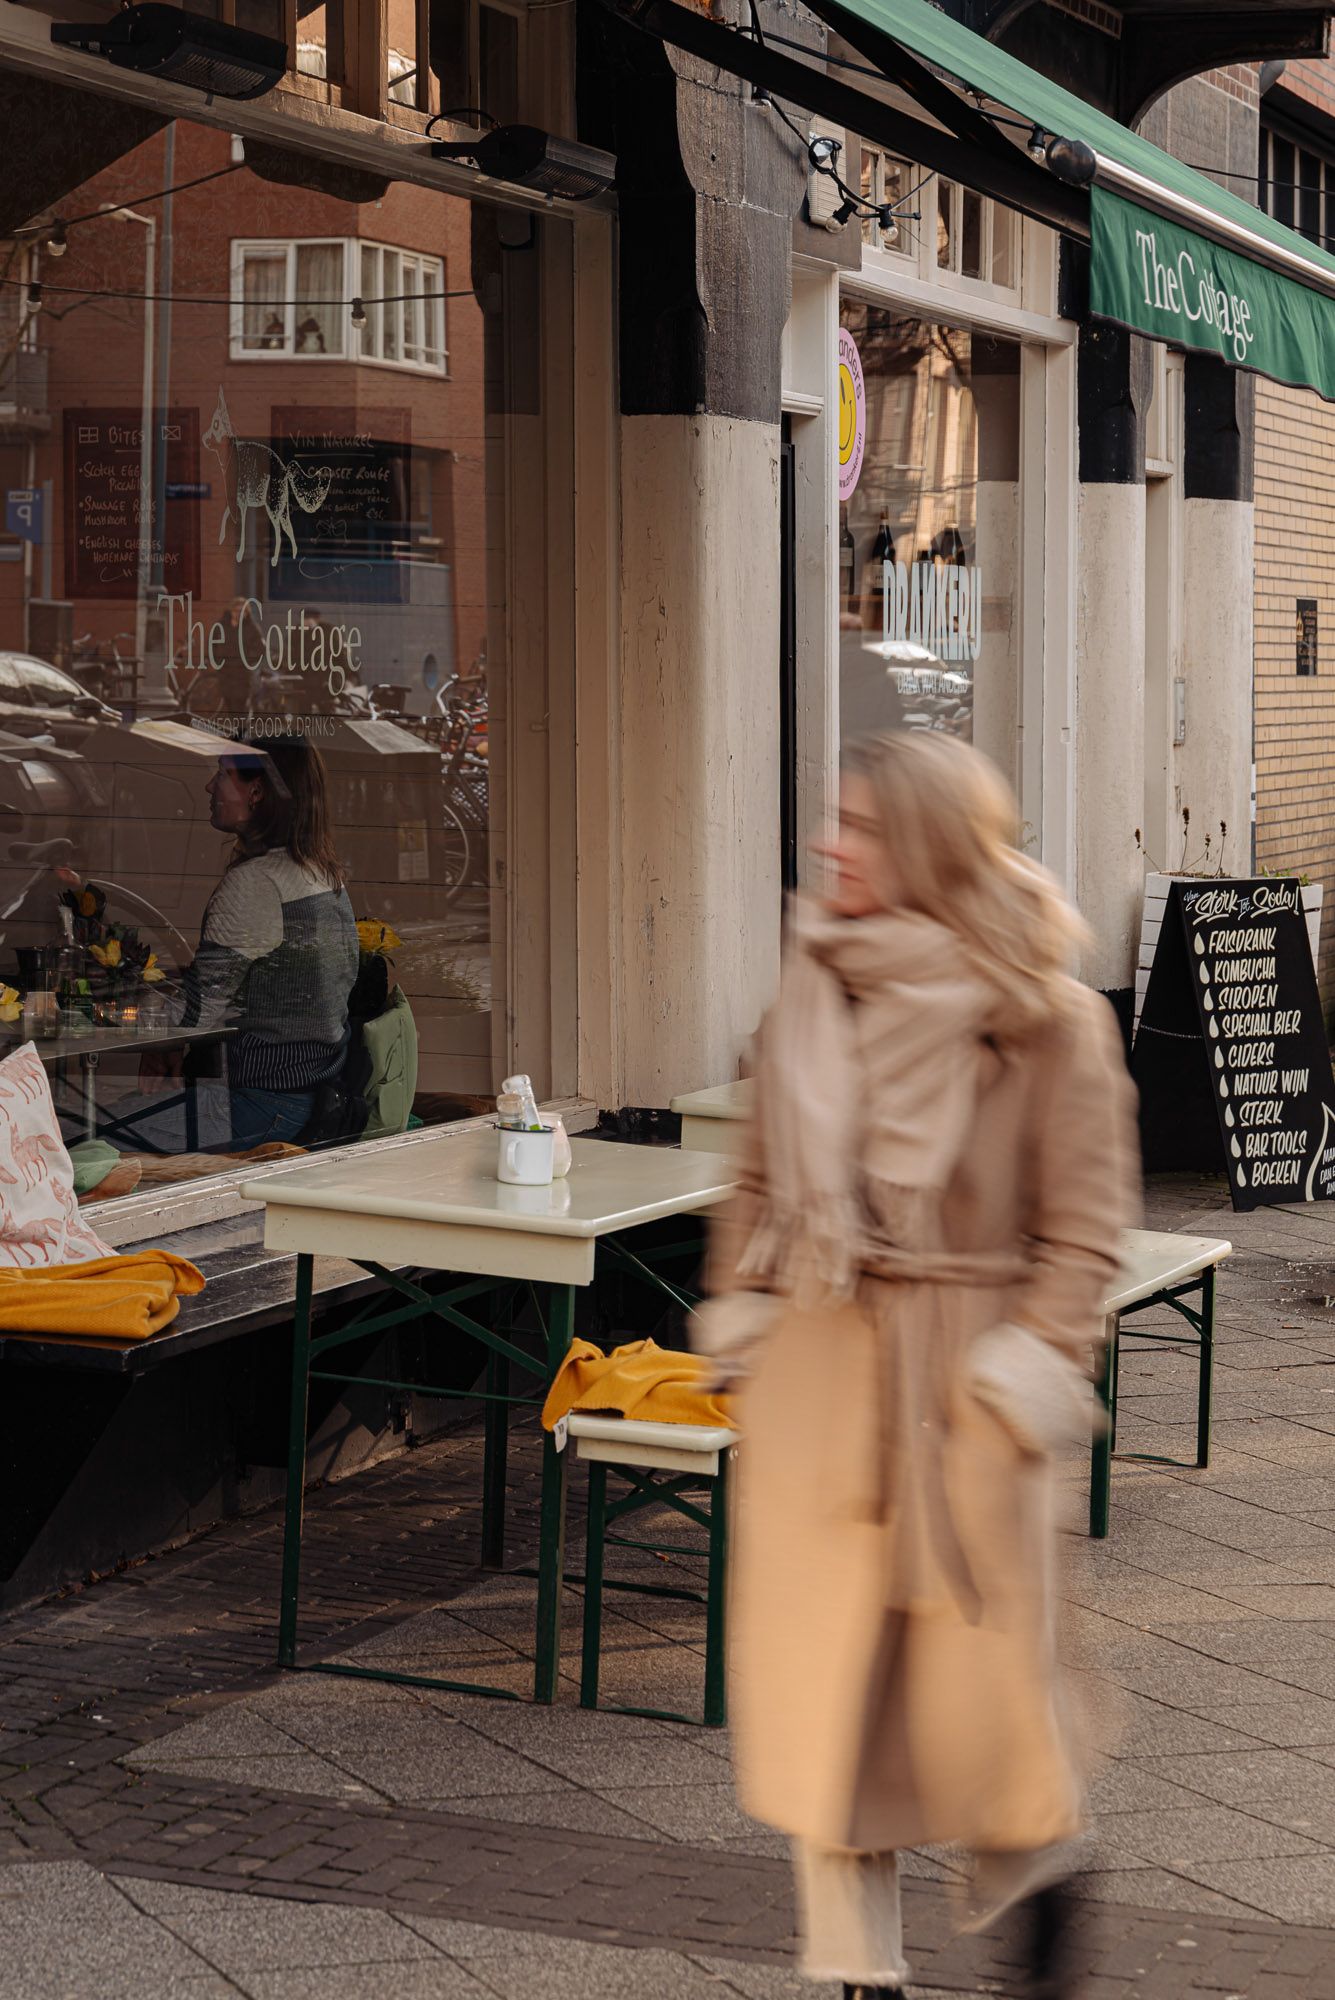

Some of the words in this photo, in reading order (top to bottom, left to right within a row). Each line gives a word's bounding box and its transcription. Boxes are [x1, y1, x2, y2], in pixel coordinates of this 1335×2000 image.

[1135, 229, 1181, 314] The
[1177, 250, 1254, 362] Cottage
[156, 590, 226, 672] The
[237, 596, 362, 696] Cottage
[249, 716, 282, 738] FOOD
[286, 719, 293, 737] &
[296, 716, 336, 738] DRINKS
[1193, 889, 1238, 924] Sterk
[1250, 883, 1299, 918] Soda!
[1208, 926, 1277, 955] FRISDRANK
[1214, 956, 1276, 984] KOMBUCHA
[1218, 984, 1279, 1011] SIROPEN
[1221, 1012, 1272, 1039] SPECIAAL
[1273, 1009, 1301, 1035] BIER
[1228, 1041, 1275, 1068] CIDERS
[1234, 1069, 1279, 1096] NATUUR
[1281, 1068, 1309, 1098] WIJN
[1239, 1100, 1284, 1127] STERK
[1245, 1132, 1269, 1158] BAR
[1270, 1130, 1308, 1155] TOOLS
[1251, 1159, 1301, 1188] BOEKEN
